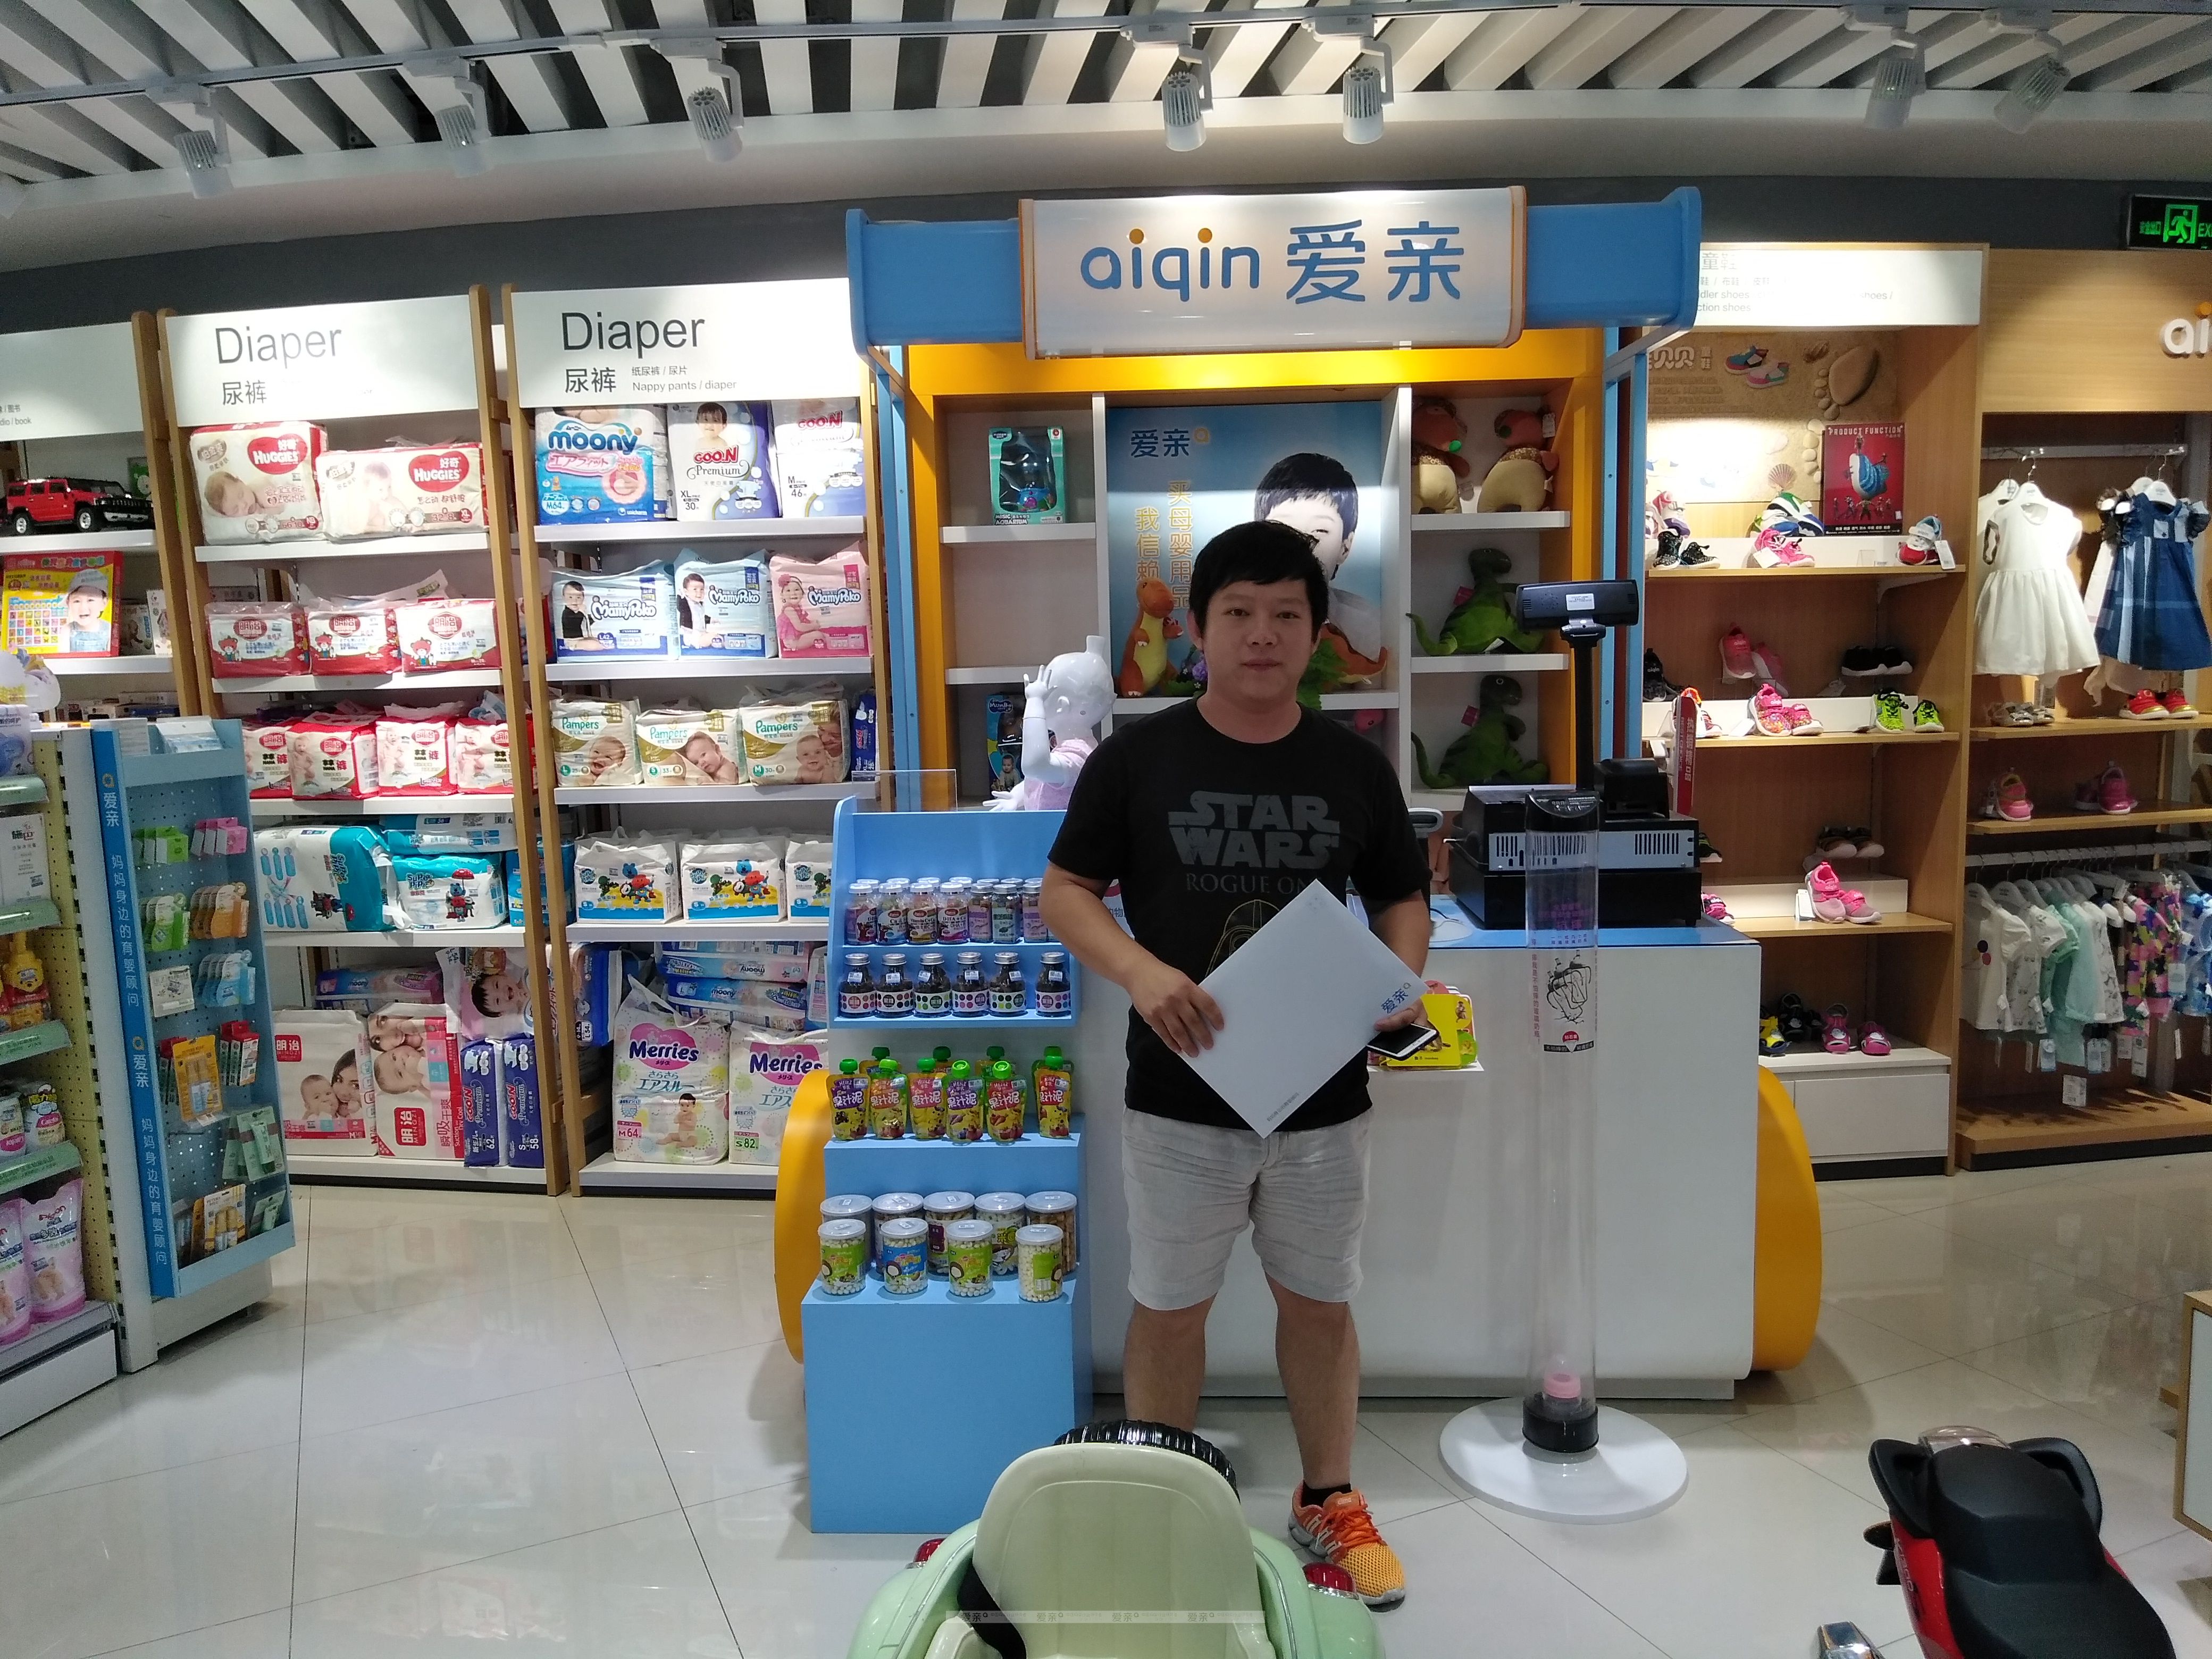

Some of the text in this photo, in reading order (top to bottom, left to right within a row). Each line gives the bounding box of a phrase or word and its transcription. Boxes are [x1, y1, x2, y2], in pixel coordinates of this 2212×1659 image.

[1081, 220, 1464, 304] aiqin 爱亲
[1721, 290, 1749, 299] shoes
[1723, 303, 1751, 312] shoes
[561, 311, 705, 359] Diaper
[216, 325, 342, 368] Diaper
[631, 365, 688, 376] 纸尿裤 尿片
[565, 367, 617, 394] 尿裤
[633, 380, 737, 394] Nappy pants diaper
[222, 380, 267, 406] 尿裤
[14, 417, 32, 425] book
[278, 439, 296, 452] 好奇
[548, 431, 638, 455] moony
[1130, 429, 1191, 458] 爱亲
[253, 449, 299, 465] HUGGIES
[439, 457, 460, 469] 好奇
[549, 454, 609, 468] エアフィット
[414, 467, 460, 482] HUGGIES
[696, 464, 741, 476] Premium
[1136, 506, 1160, 582] 我信赖
[1168, 480, 1194, 609] 买母婴用品
[708, 585, 760, 606] MamyPoko
[808, 586, 861, 606] MamyPoko
[591, 596, 657, 621] MamyPoko
[562, 717, 599, 731] Pampers
[756, 720, 798, 734] Pampers
[650, 727, 688, 740] Pampers
[1685, 717, 1694, 782] 热销精品
[103, 791, 119, 827] 爱亲
[1168, 790, 1340, 834] STAR
[1170, 827, 1340, 870] WARS
[1186, 872, 1321, 894] ROGUE ON
[111, 854, 140, 1008] 妈妈身边的育婴顾问
[1381, 987, 1409, 1015] 爱亲
[276, 1040, 299, 1051] 明治
[630, 1041, 699, 1062] Merries
[132, 1054, 149, 1088] 爱亲
[648, 1071, 679, 1080] さらさら
[636, 1078, 696, 1092] エアスルー
[833, 1091, 864, 1108] 果汁泥
[870, 1091, 900, 1107] 果汁泥
[911, 1090, 941, 1107] 果汁泥
[946, 1093, 977, 1109] 果汁泥
[988, 1091, 1020, 1109] 果汁泥
[1040, 1090, 1063, 1103] 果汁泥
[400, 1110, 413, 1143] 明治
[436, 1099, 453, 1147] 瞬吸干爽
[627, 1128, 638, 1138] 64
[486, 1137, 495, 1151] 62
[530, 1138, 539, 1150] 58
[744, 1138, 755, 1149] 82
[141, 1118, 168, 1265] 妈妈身边的育婴顾问
